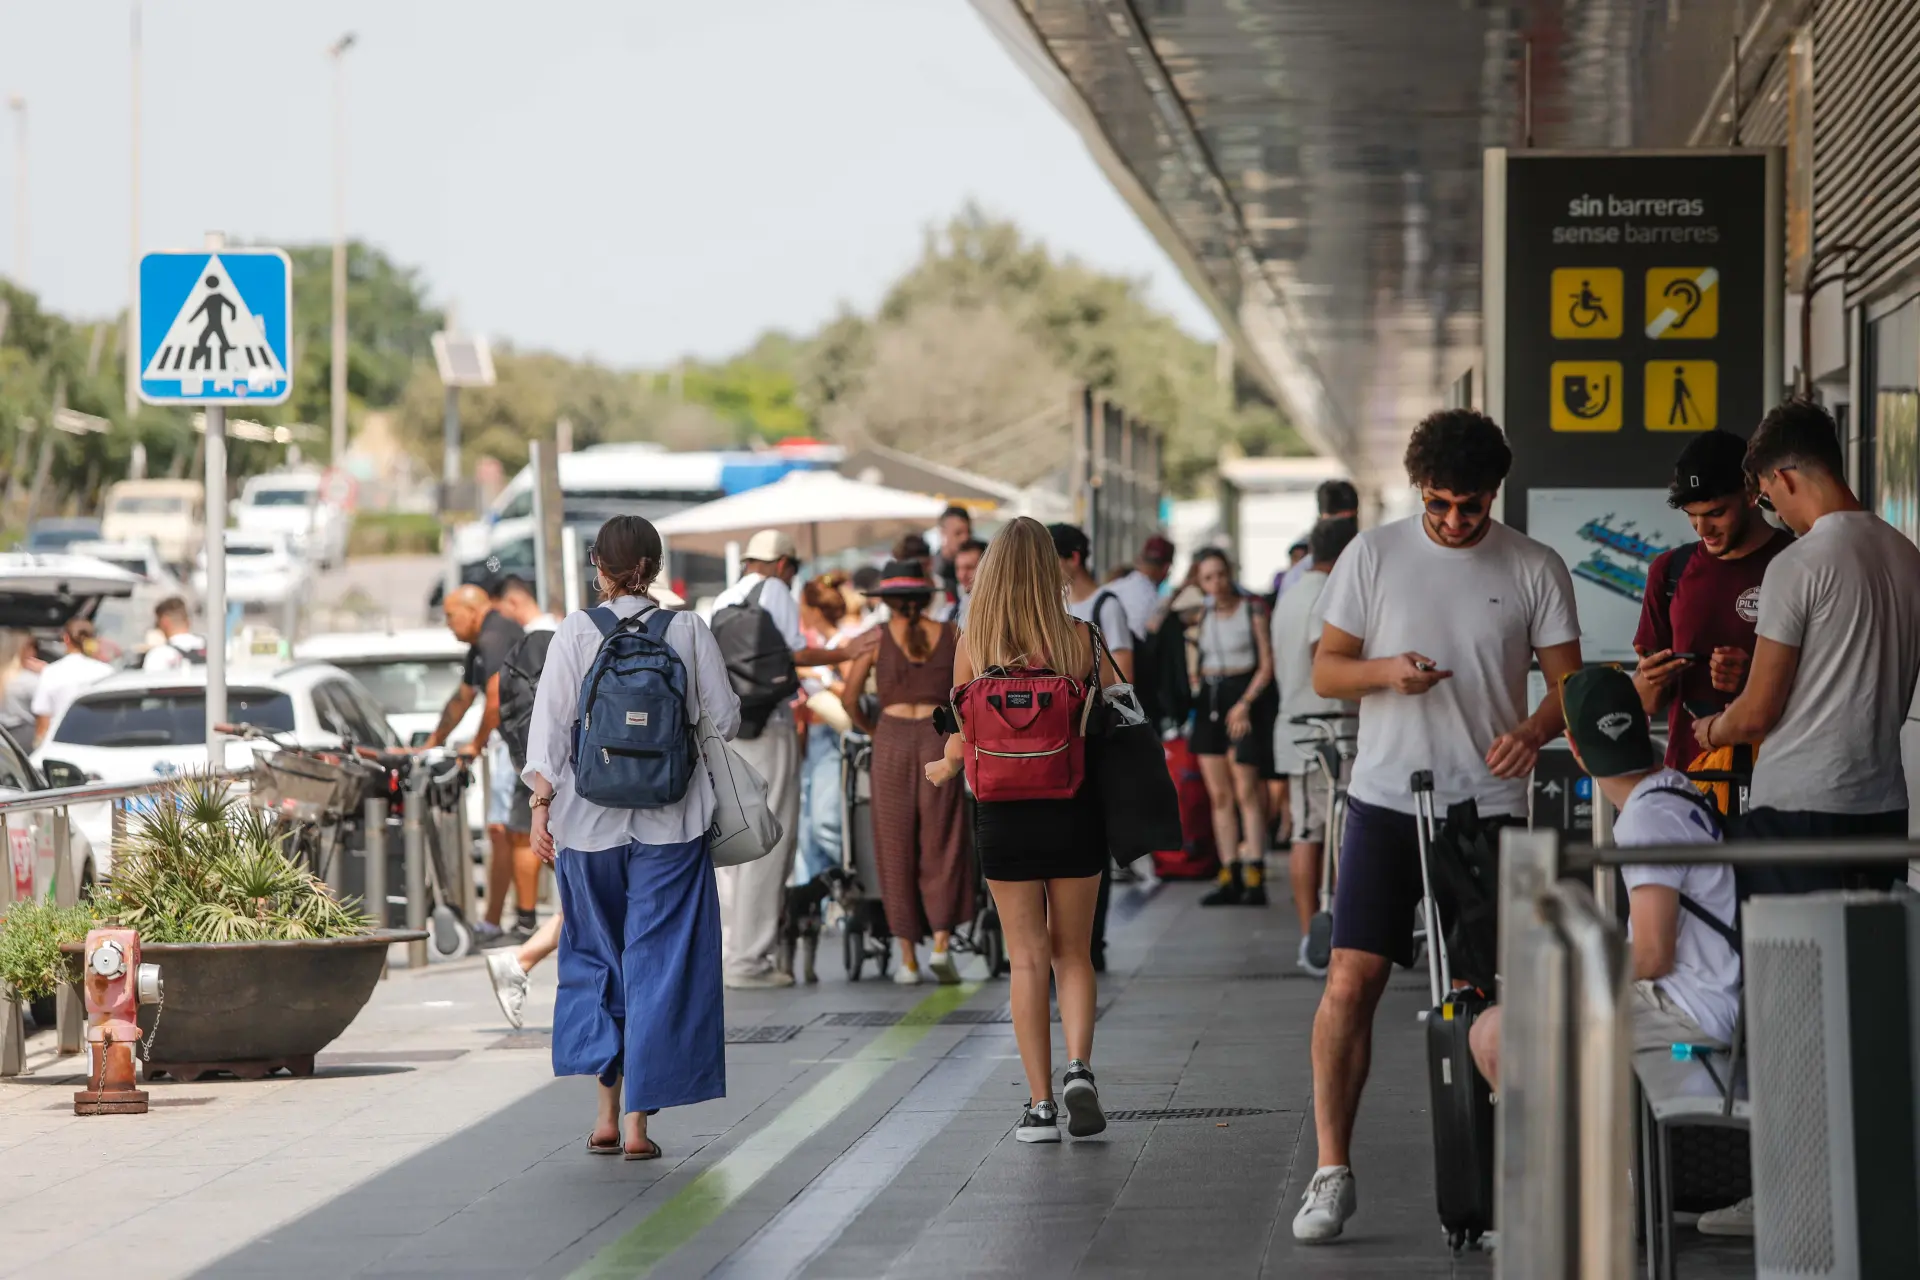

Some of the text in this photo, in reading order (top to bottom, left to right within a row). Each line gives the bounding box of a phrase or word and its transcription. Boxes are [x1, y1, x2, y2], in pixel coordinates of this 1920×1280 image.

[1568, 193, 1704, 217] sin barreras
[1552, 221, 1719, 244] sense barreres
